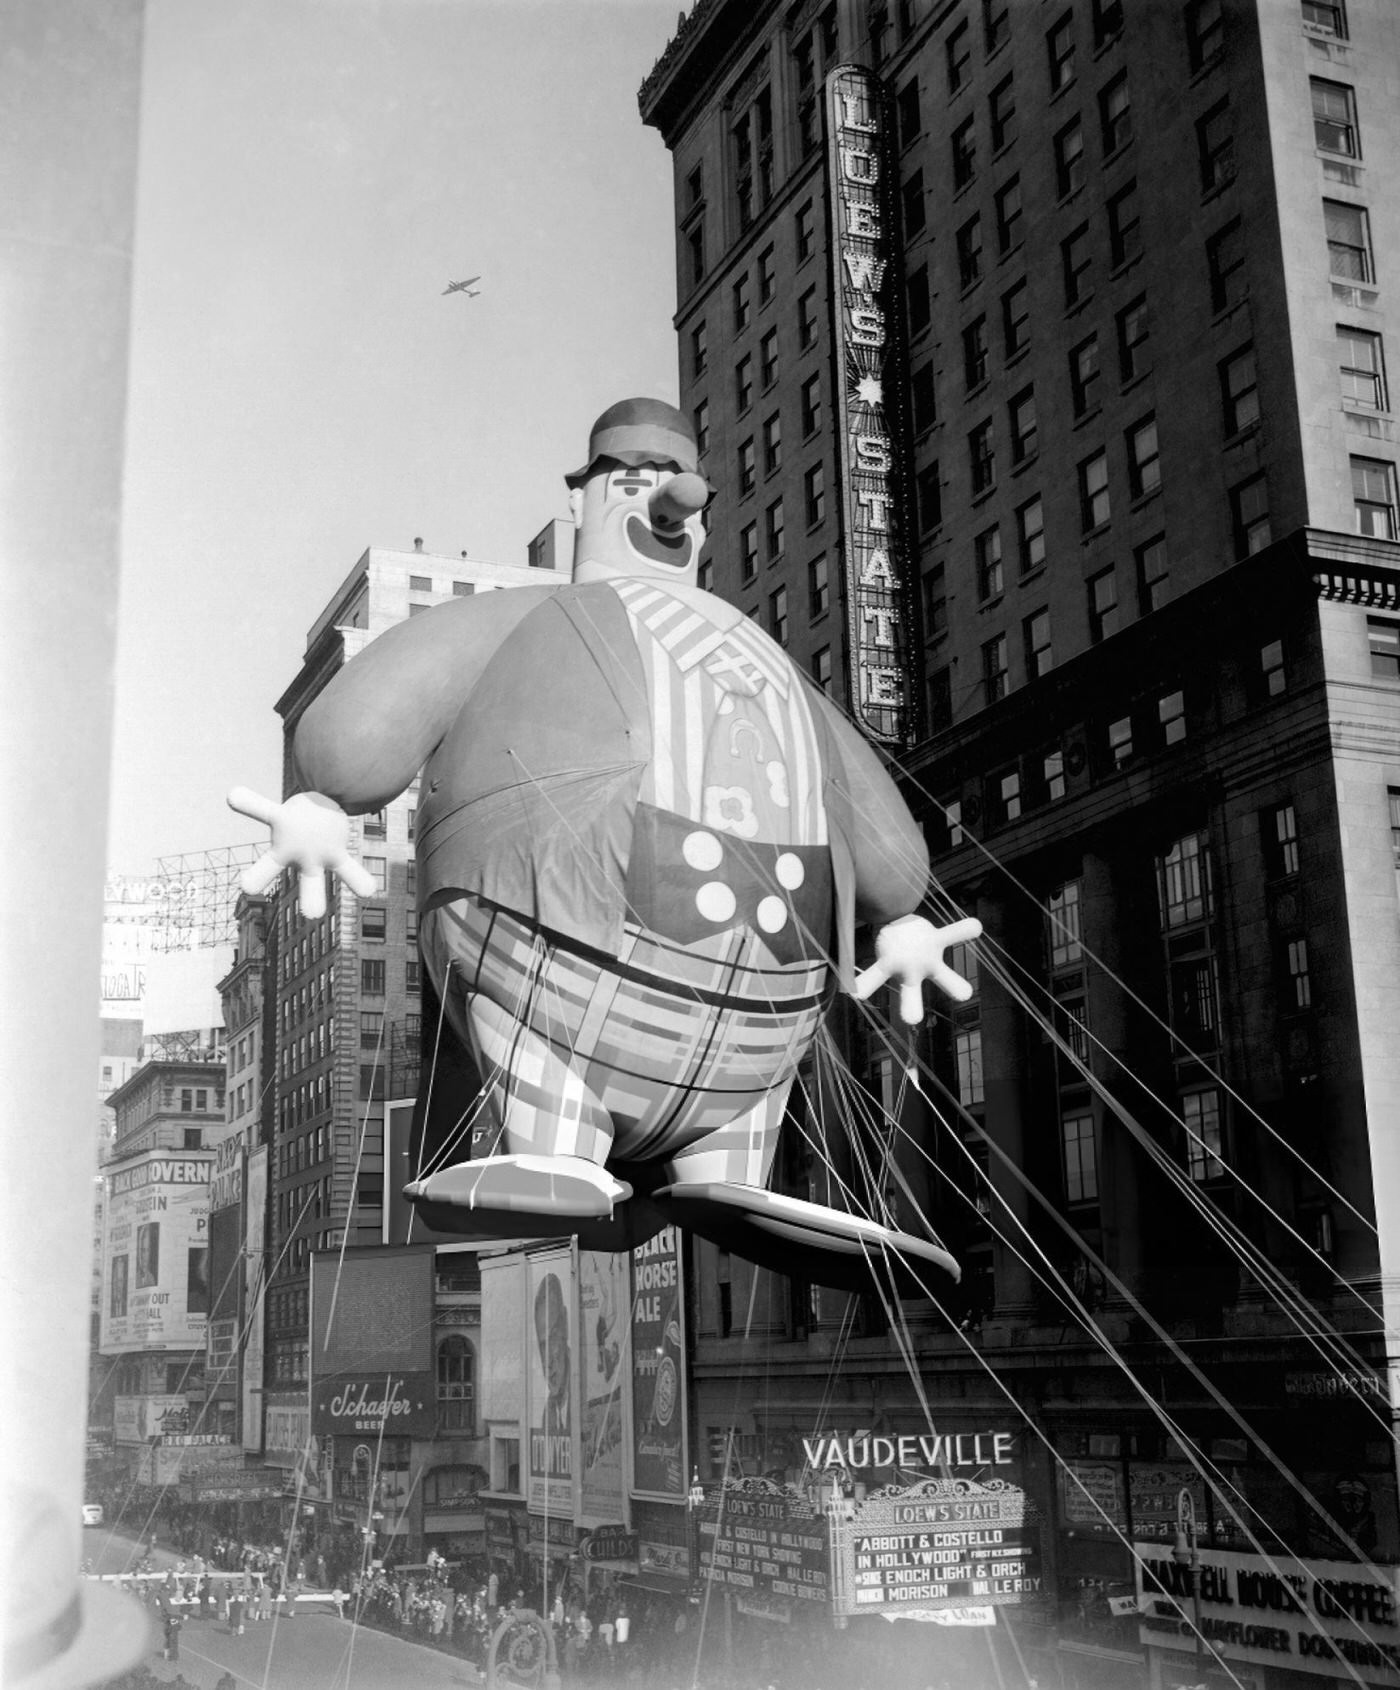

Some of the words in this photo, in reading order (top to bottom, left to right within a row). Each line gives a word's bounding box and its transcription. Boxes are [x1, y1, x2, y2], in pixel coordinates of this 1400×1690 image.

[855, 433, 902, 707] STATE
[635, 1260, 676, 1291] HORSE
[635, 1296, 661, 1323] ALE
[331, 1380, 411, 1419] Schaefer
[355, 1420, 384, 1430] BEER
[802, 1433, 1013, 1469] VAUDEVILLE
[758, 1502, 784, 1520] STATE
[954, 1501, 999, 1521] STATE
[854, 1535, 915, 1551] "ABBOTT
[919, 1534, 930, 1548] &
[934, 1530, 1003, 1547] COSTELLO
[857, 1555, 872, 1568] IN
[876, 1549, 967, 1567] HOLLYWOOD"
[886, 1569, 930, 1584] ENOCH
[934, 1565, 972, 1581] LIGHT
[976, 1564, 987, 1577] &
[991, 1561, 1026, 1577] ORCH
[889, 1584, 948, 1601] MORISON
